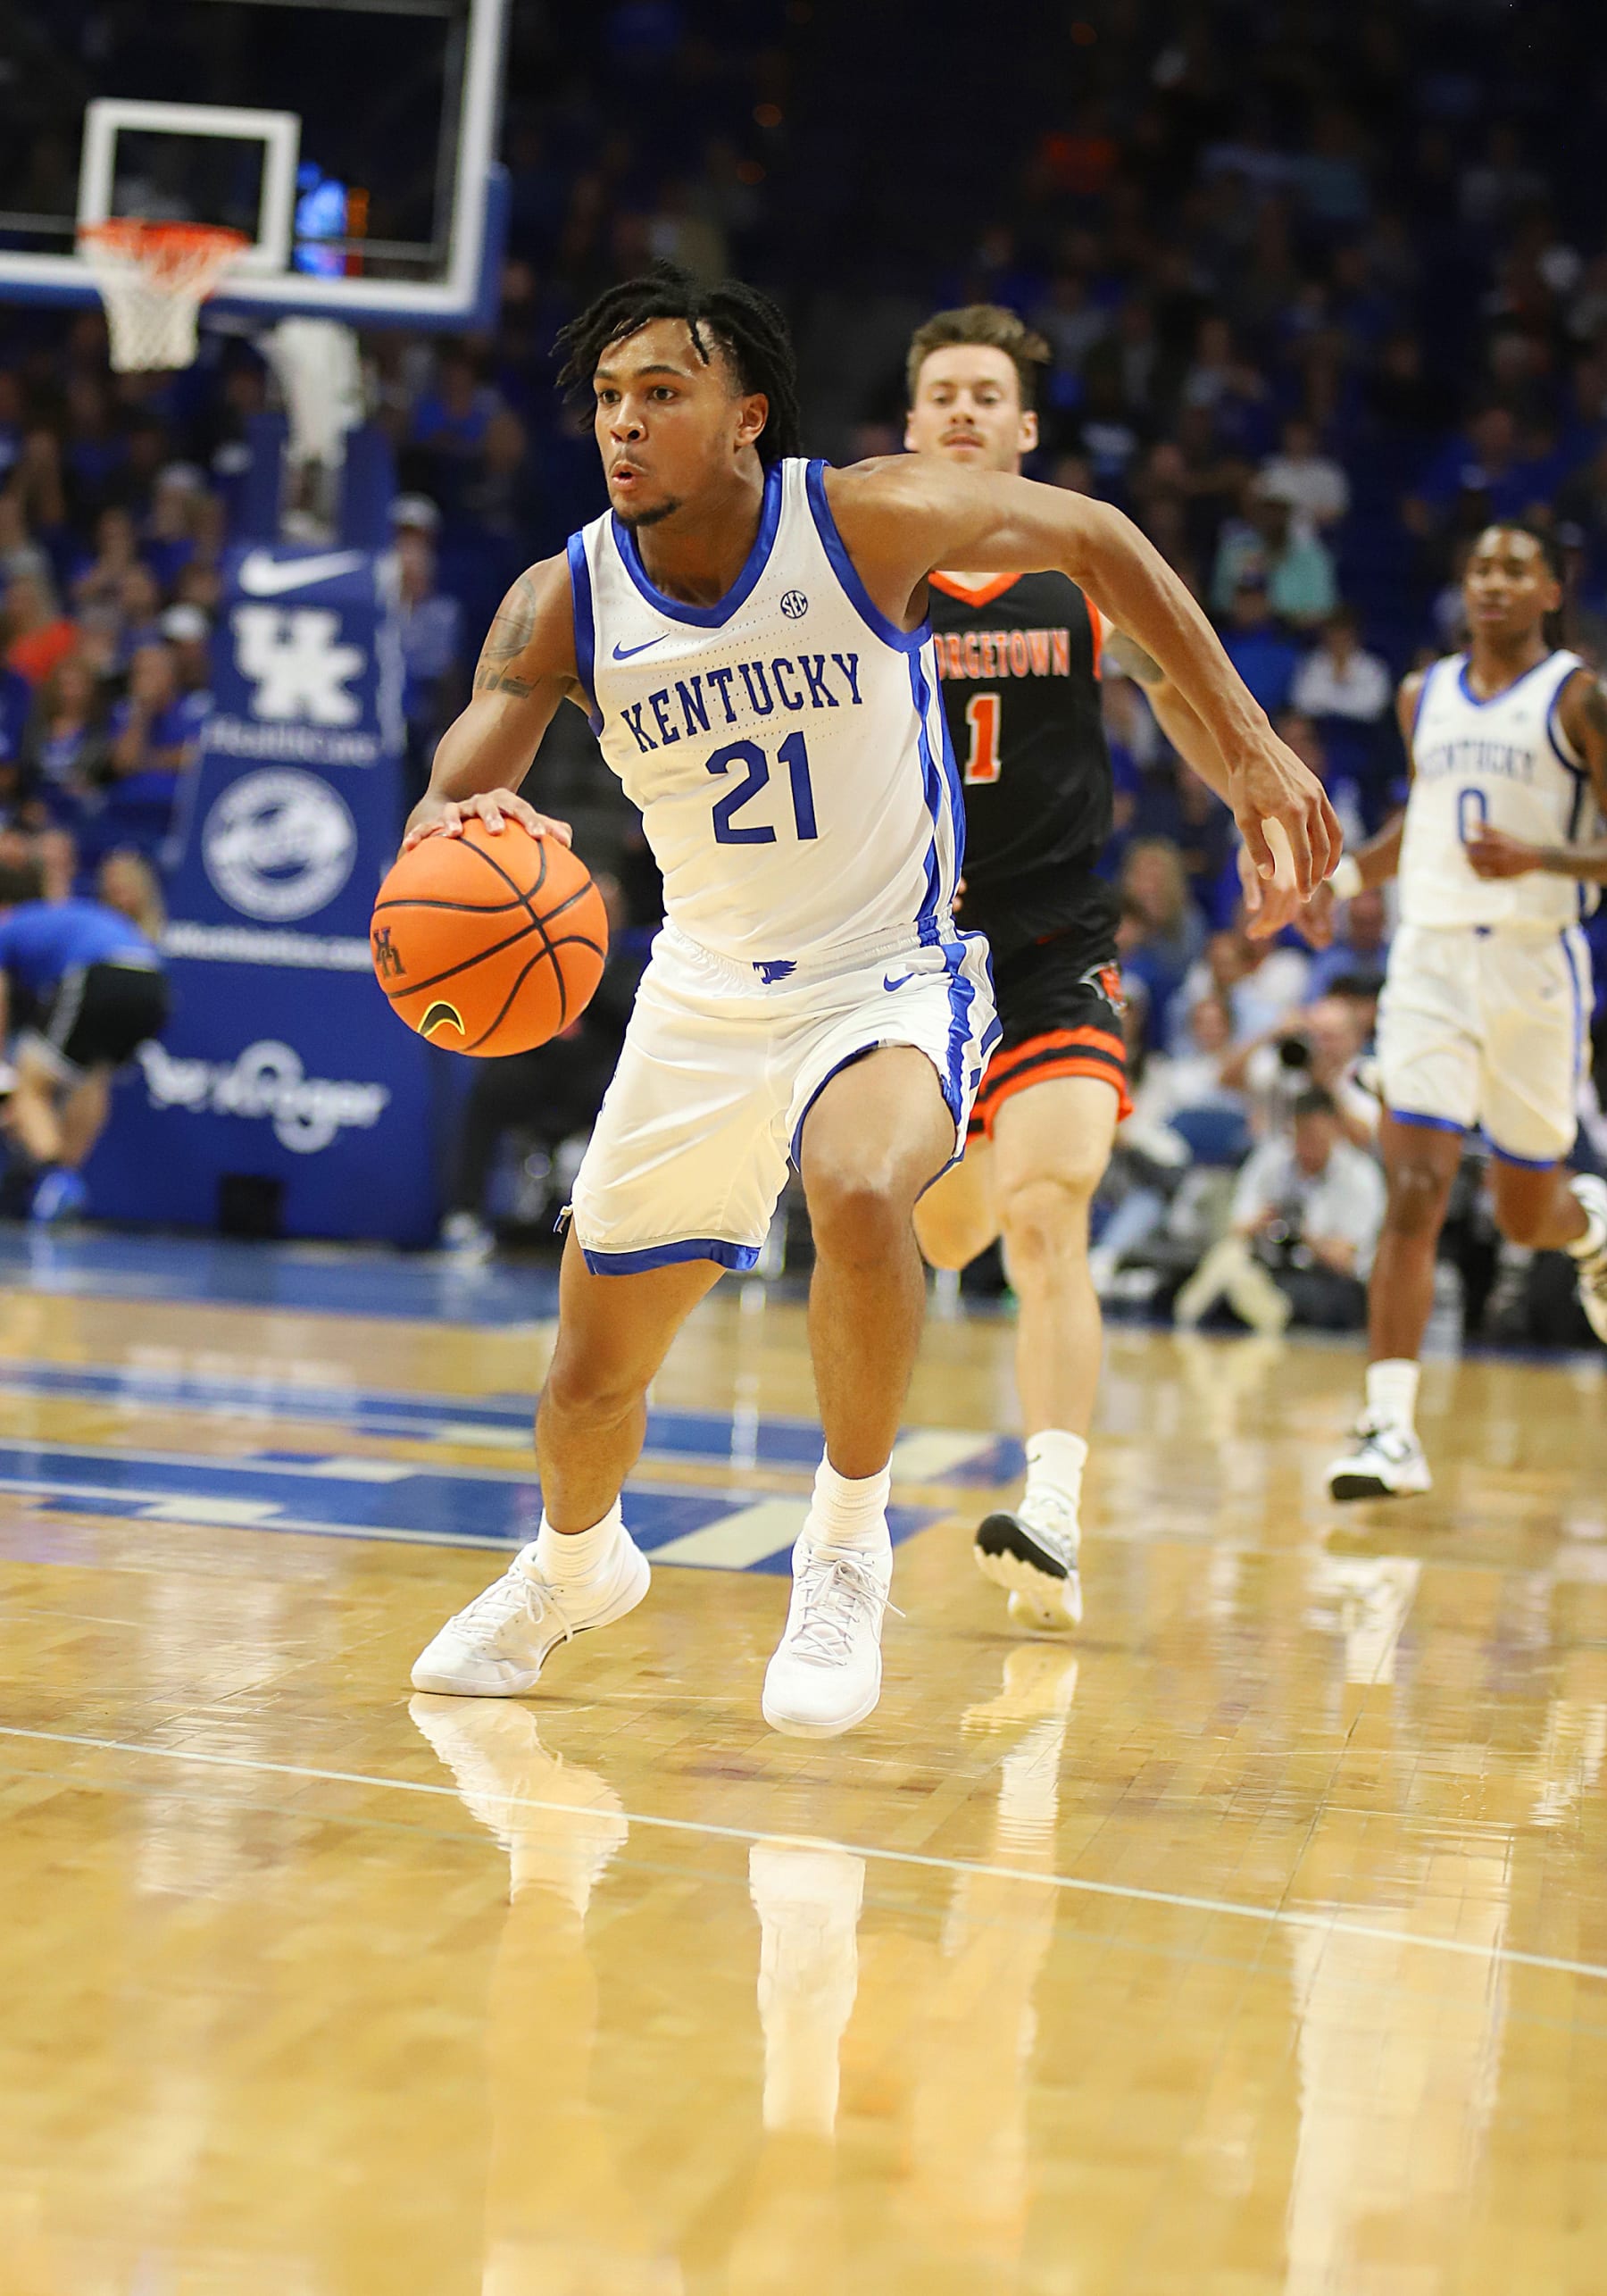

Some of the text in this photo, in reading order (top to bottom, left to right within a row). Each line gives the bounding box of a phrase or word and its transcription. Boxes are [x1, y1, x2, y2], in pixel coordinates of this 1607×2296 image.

[780, 589, 808, 618] SEC
[231, 603, 367, 726] UK
[620, 653, 862, 753] KENTUCKY
[705, 731, 818, 844] 21
[964, 692, 1002, 786] 1
[1457, 788, 1486, 846] 0
